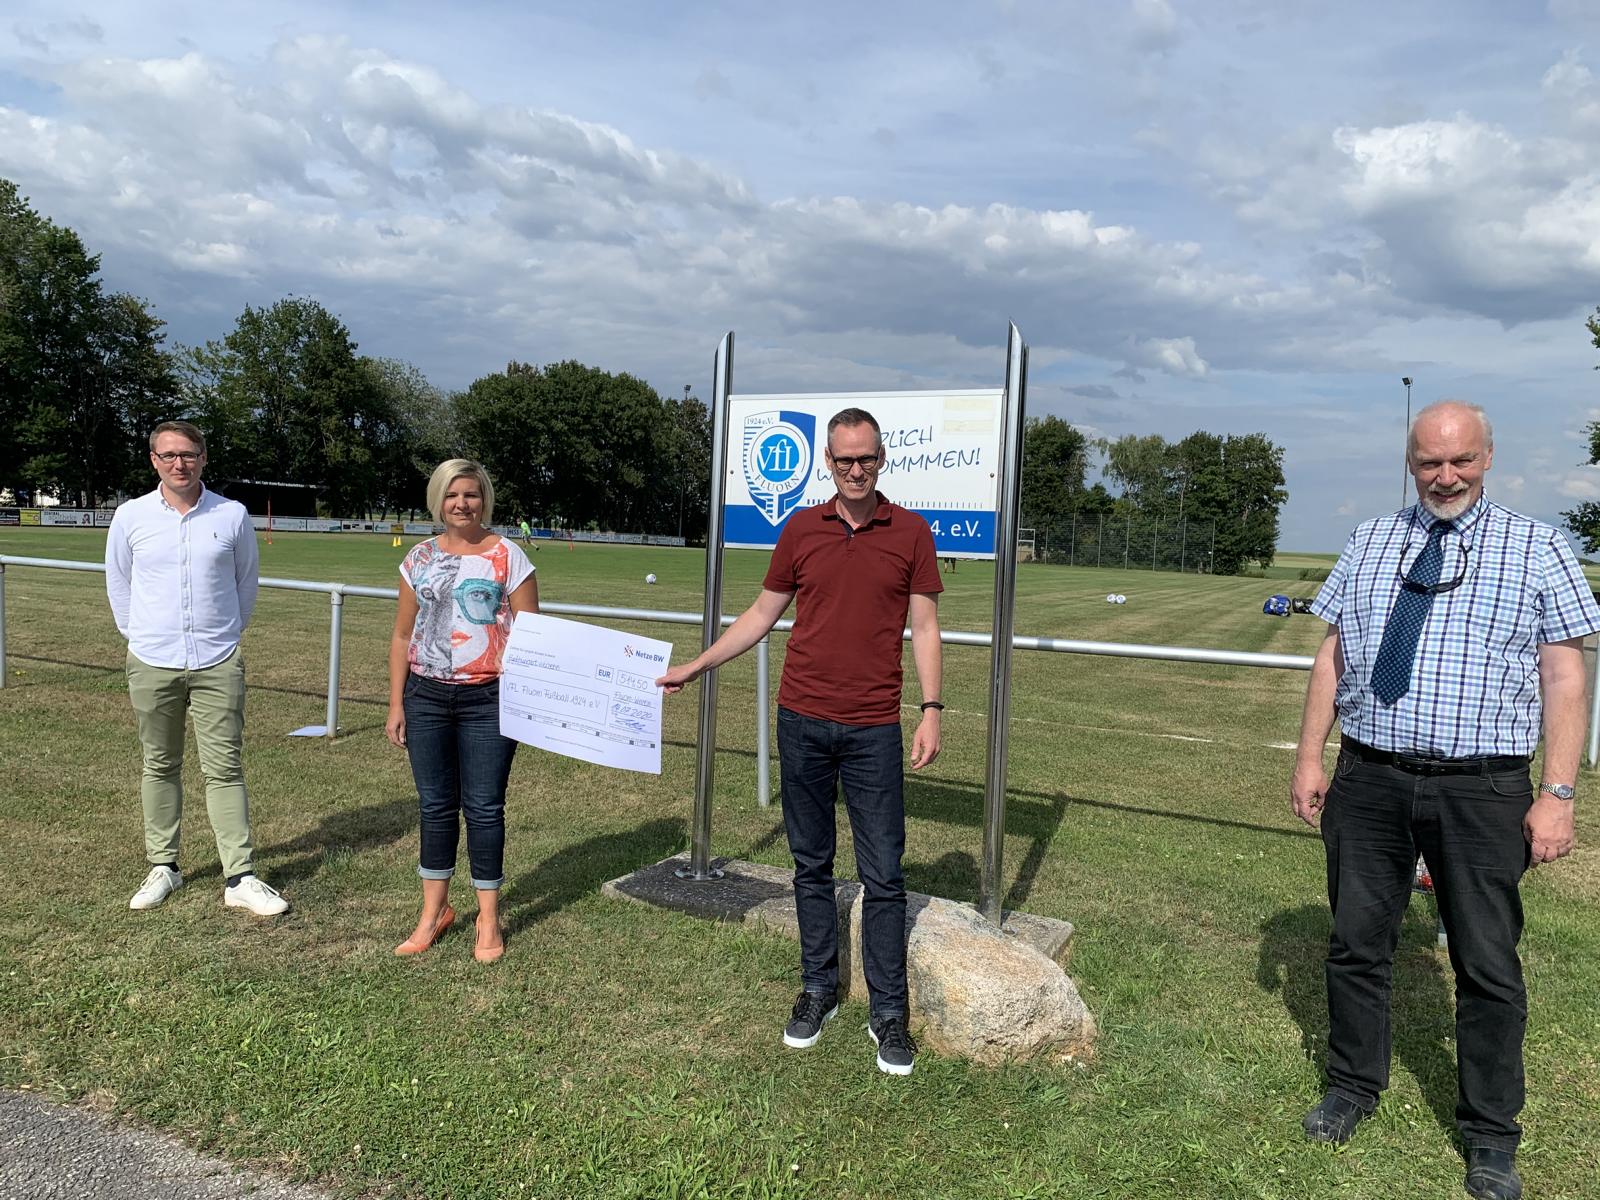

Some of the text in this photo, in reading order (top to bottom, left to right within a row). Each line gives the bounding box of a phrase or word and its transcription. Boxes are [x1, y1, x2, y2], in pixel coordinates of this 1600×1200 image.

[746, 417, 761, 425] 1924
[754, 473, 800, 493] FLUORN
[950, 520, 982, 538] e.V.
[635, 649, 665, 663] Netze BW
[598, 669, 612, 679] EUR
